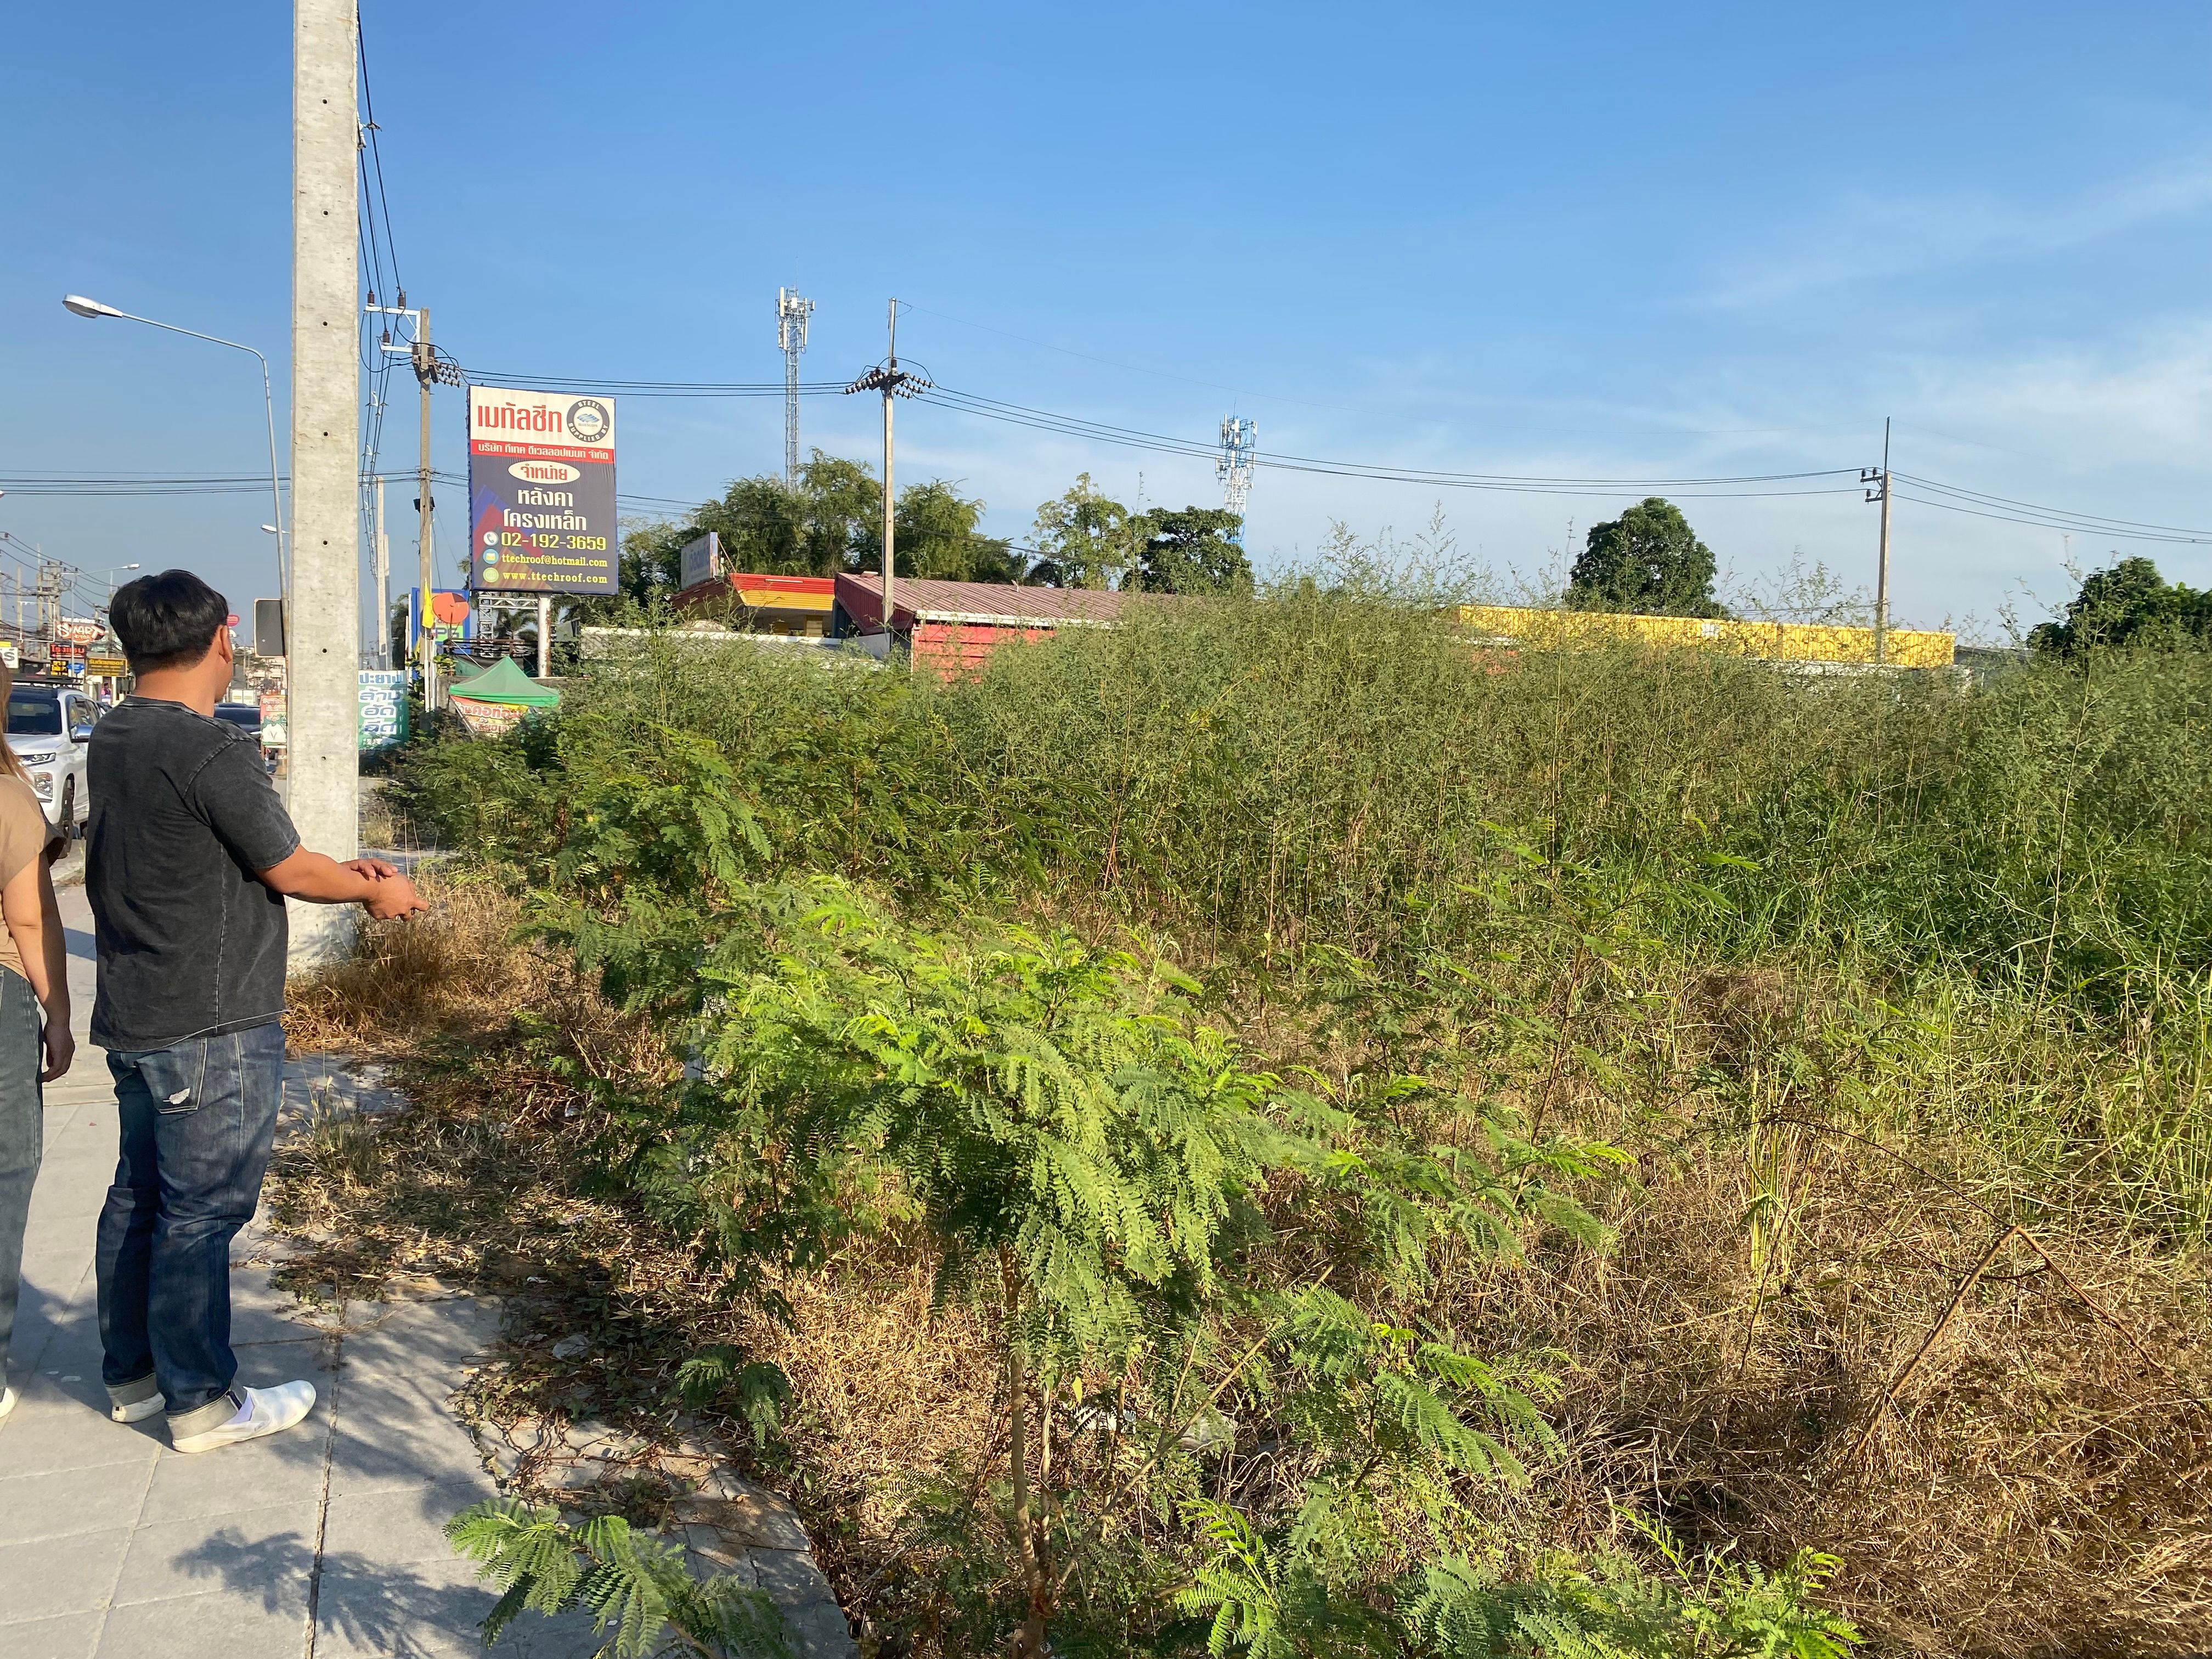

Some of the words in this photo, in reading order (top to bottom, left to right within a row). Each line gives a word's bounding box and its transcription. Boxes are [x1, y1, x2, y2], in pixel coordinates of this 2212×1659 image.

[478, 402, 562, 432] เมทัลชีท
[568, 423, 600, 441] SUPPLIED
[601, 425, 608, 435] BY
[478, 443, 502, 452] บริษัท
[588, 449, 608, 459] จำกัด
[521, 464, 567, 480] จำหน่าย
[518, 487, 573, 506] หลังคา
[504, 509, 586, 531] โครงเหล็ก
[501, 532, 606, 550] 02-192-3659
[502, 554, 608, 567] ttechroof@hotmail.com
[503, 572, 607, 583] www.ttechroof.com
